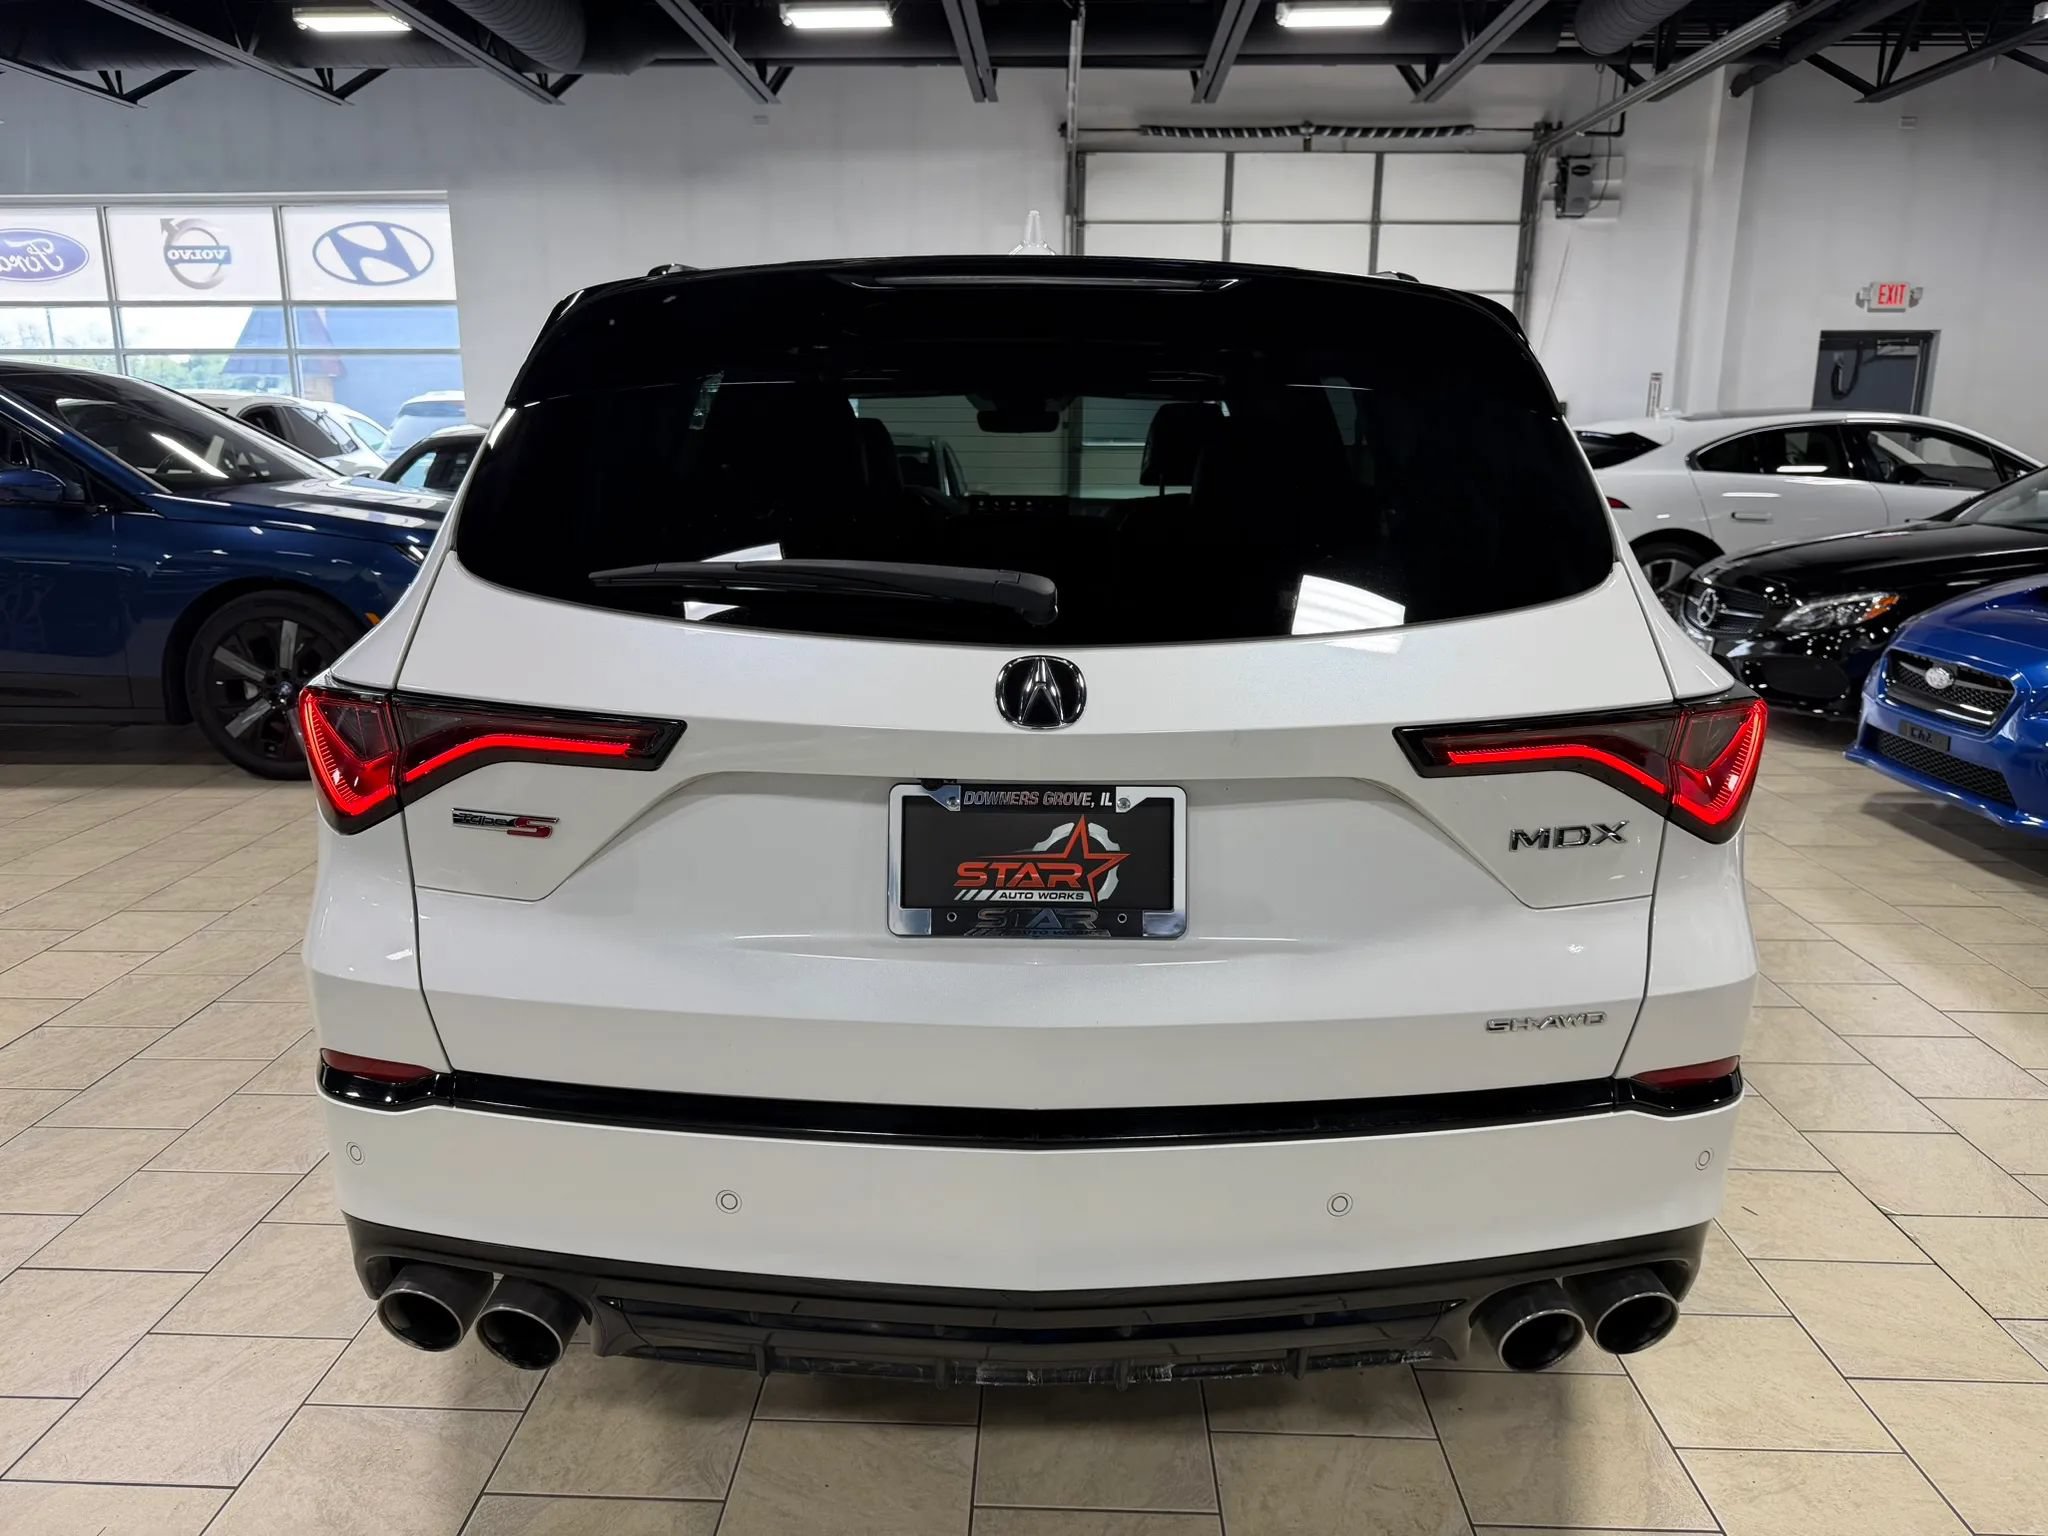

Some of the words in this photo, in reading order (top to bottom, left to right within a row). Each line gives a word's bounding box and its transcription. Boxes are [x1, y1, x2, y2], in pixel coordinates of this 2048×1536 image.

[1878, 284, 1906, 304] EXIT
[963, 791, 1040, 806] DOWNERS
[1043, 791, 1095, 808] GROVE,
[1100, 792, 1113, 806] IL
[1509, 820, 1629, 852] MDX
[953, 862, 1083, 888] STAR
[999, 892, 1034, 900] AUTO
[1038, 892, 1085, 900] WORKS
[975, 907, 1099, 929] STAR
